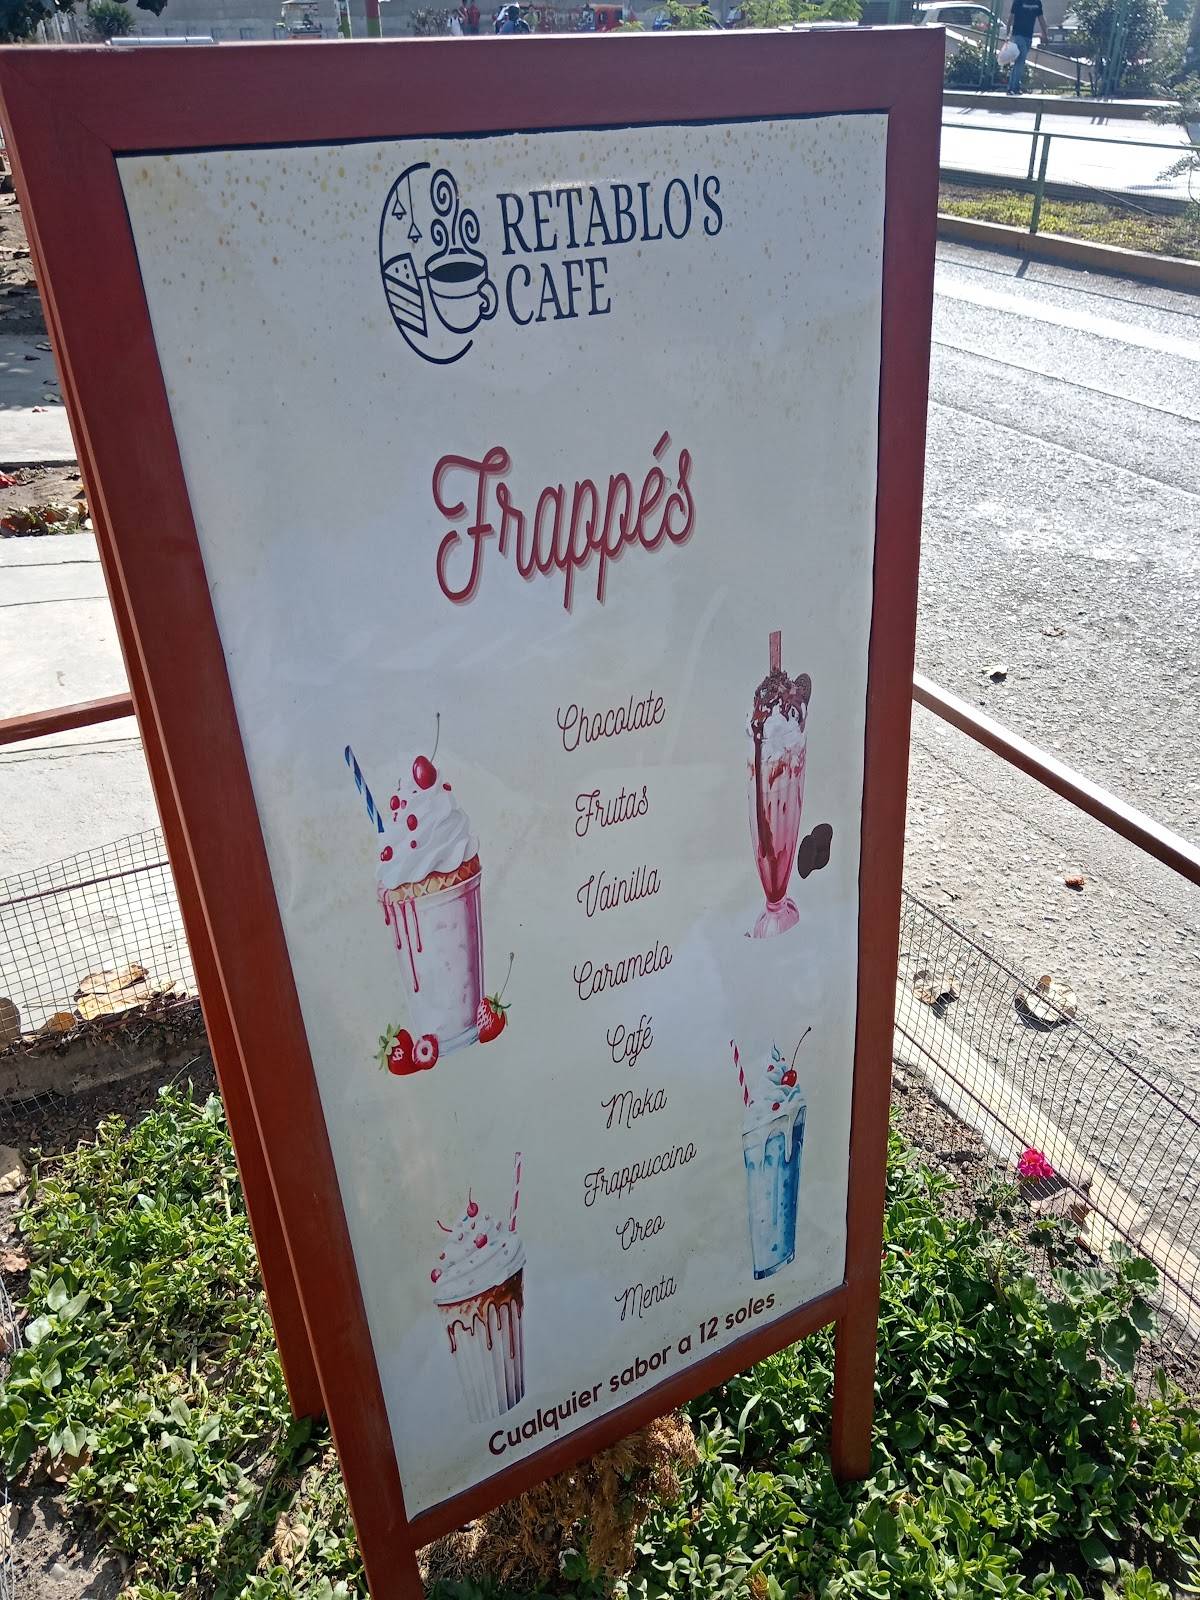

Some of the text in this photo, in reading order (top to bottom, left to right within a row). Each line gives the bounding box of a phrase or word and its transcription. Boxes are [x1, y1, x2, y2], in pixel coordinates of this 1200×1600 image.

[496, 173, 723, 255] RETABLO'S
[505, 256, 611, 325] CAFE
[432, 430, 697, 614] Frappés
[557, 690, 665, 752] Chocolate
[575, 785, 649, 837] Frutas
[576, 865, 661, 918] Vainilla
[573, 940, 672, 1001] Caramelo
[606, 1014, 653, 1067] Café
[601, 1088, 667, 1129] Moka
[584, 1142, 697, 1207] Frappuccino
[616, 1215, 665, 1251] Oreo
[614, 1274, 677, 1321] Menta
[488, 1292, 776, 1455] Cualquier sabor a 12 soles
